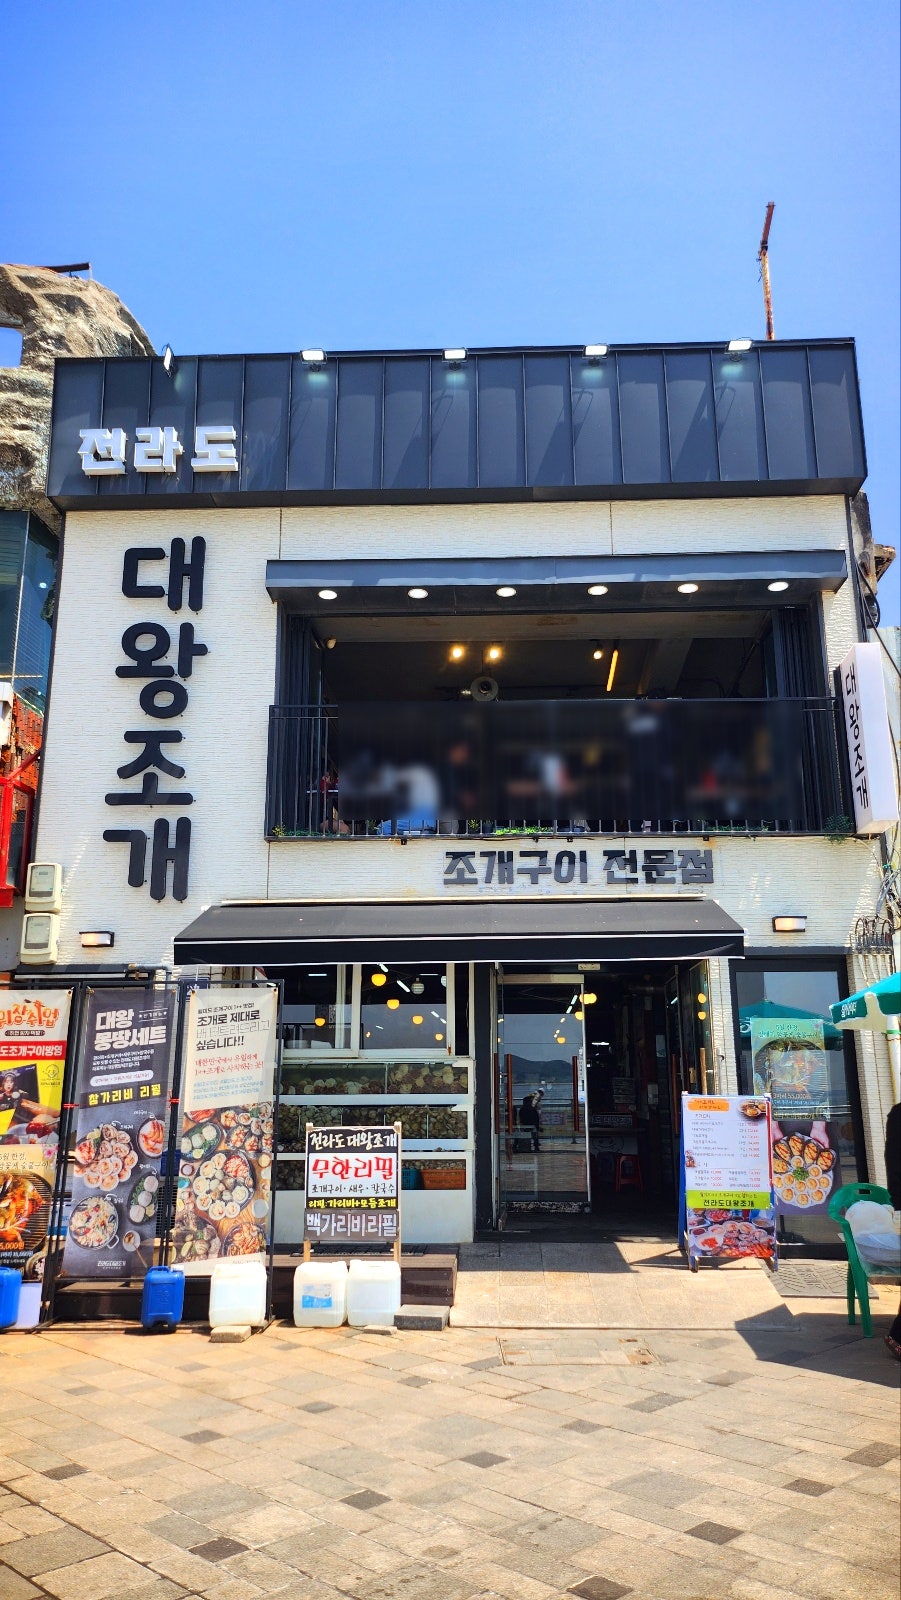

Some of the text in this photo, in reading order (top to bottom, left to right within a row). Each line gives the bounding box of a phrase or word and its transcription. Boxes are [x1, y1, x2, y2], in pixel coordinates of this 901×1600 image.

[77, 425, 239, 476] 전라도
[102, 535, 208, 901] 대왕조개
[844, 663, 869, 809] 대왕조개
[443, 849, 714, 884] 조개구이 전문점
[95, 1009, 135, 1031] 대왕
[197, 1009, 260, 1027] 조개로 제대로
[94, 1025, 167, 1051] 몽땅세트
[196, 1035, 244, 1051] 싶습니다!!
[89, 1083, 161, 1106] 참가리비 리필
[312, 1156, 393, 1180] 무한리필
[311, 1182, 396, 1194] 조개구이 새우 칼국수
